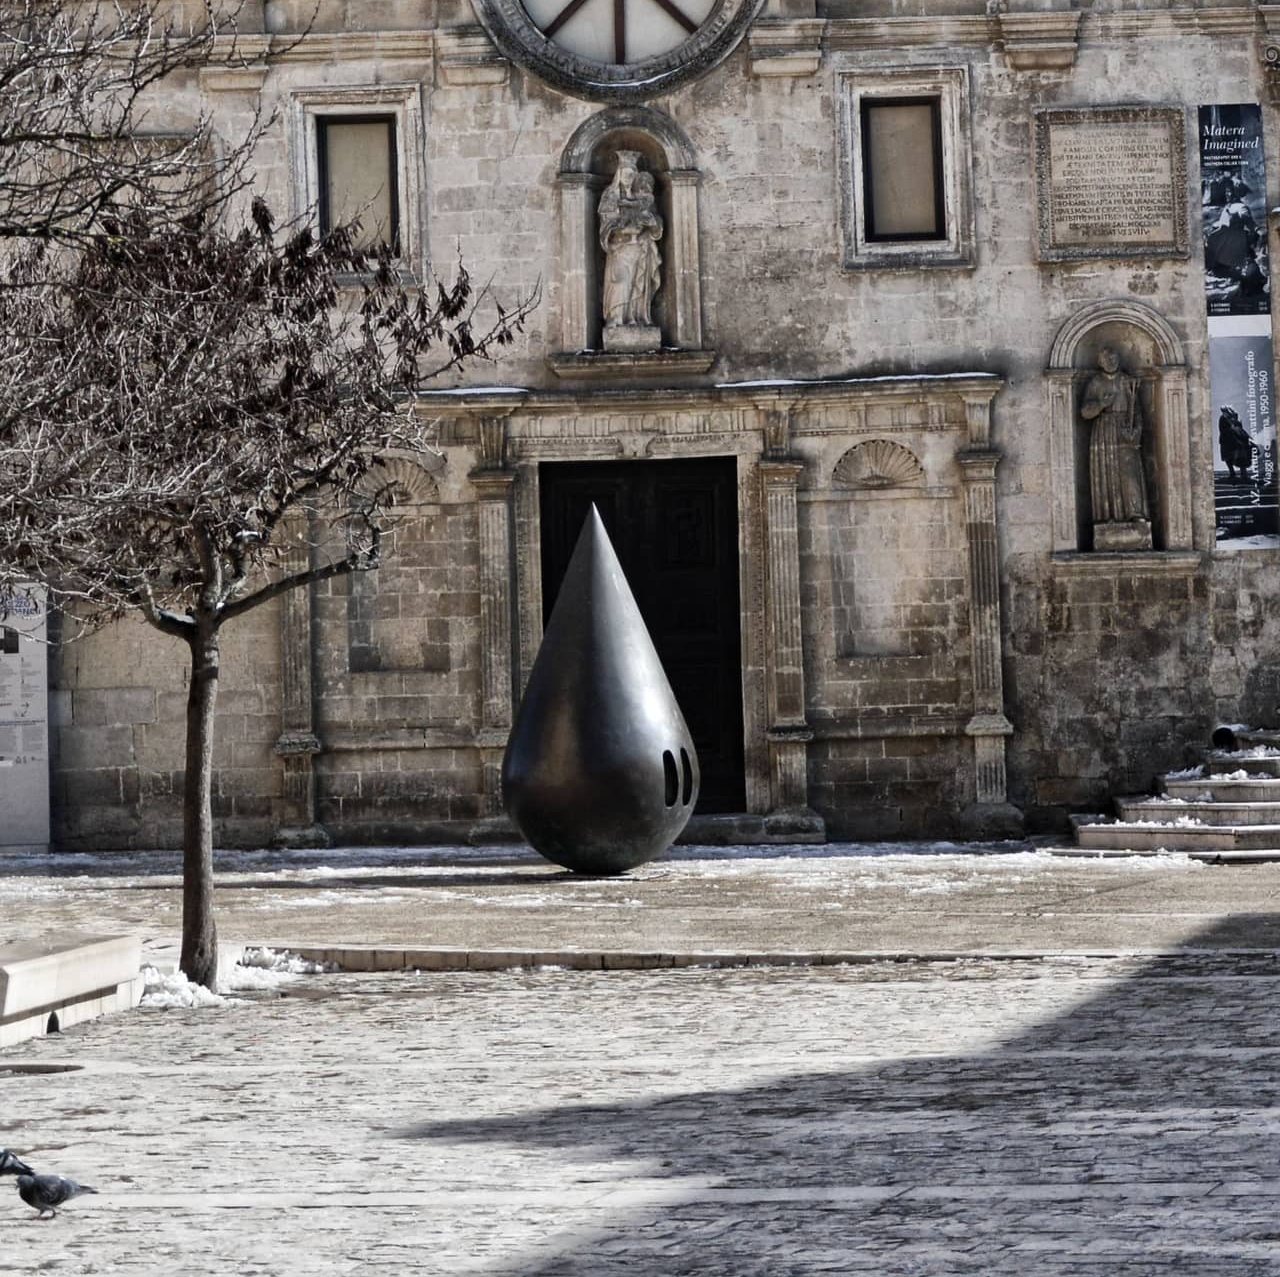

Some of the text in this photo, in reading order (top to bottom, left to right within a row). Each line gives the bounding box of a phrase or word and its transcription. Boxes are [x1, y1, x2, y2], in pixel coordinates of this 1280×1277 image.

[1203, 124, 1246, 136] Matera
[1204, 136, 1260, 153] Imagined
[1245, 350, 1258, 398] fotografo
[1259, 370, 1270, 415] 1950-1960
[1251, 447, 1260, 482] Arturo
[1263, 459, 1274, 486] Viaggi
